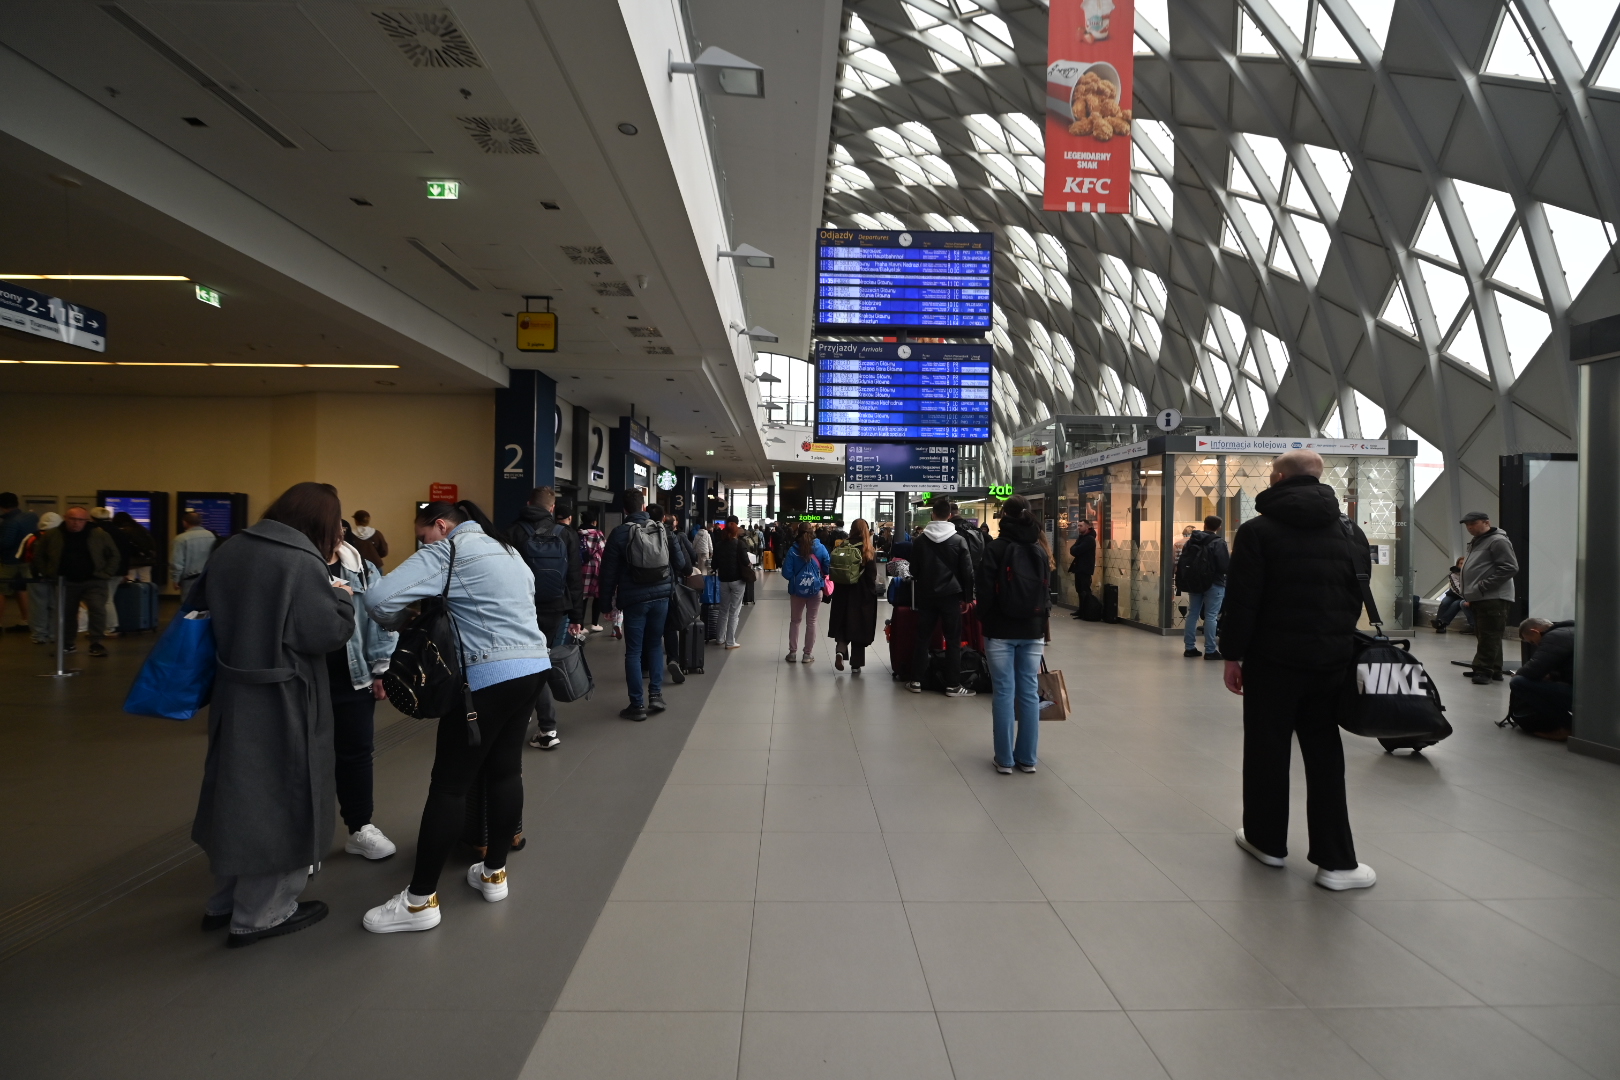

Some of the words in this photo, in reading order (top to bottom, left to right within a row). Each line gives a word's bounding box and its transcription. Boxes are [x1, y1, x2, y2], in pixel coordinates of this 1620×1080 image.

[1064, 151, 1111, 160] LEGENDARNY
[1077, 161, 1098, 169] SMAK
[1063, 177, 1111, 194] KFC
[820, 231, 853, 240] Odjazdy
[26, 298, 66, 322] 2-11
[819, 344, 857, 353] Przyjazdy
[1211, 440, 1251, 449] Informacja
[1254, 441, 1286, 449] kolejowa
[504, 444, 523, 472] 2
[989, 483, 1012, 495] żab
[675, 495, 684, 508] 3
[1357, 663, 1428, 696] NIKE
